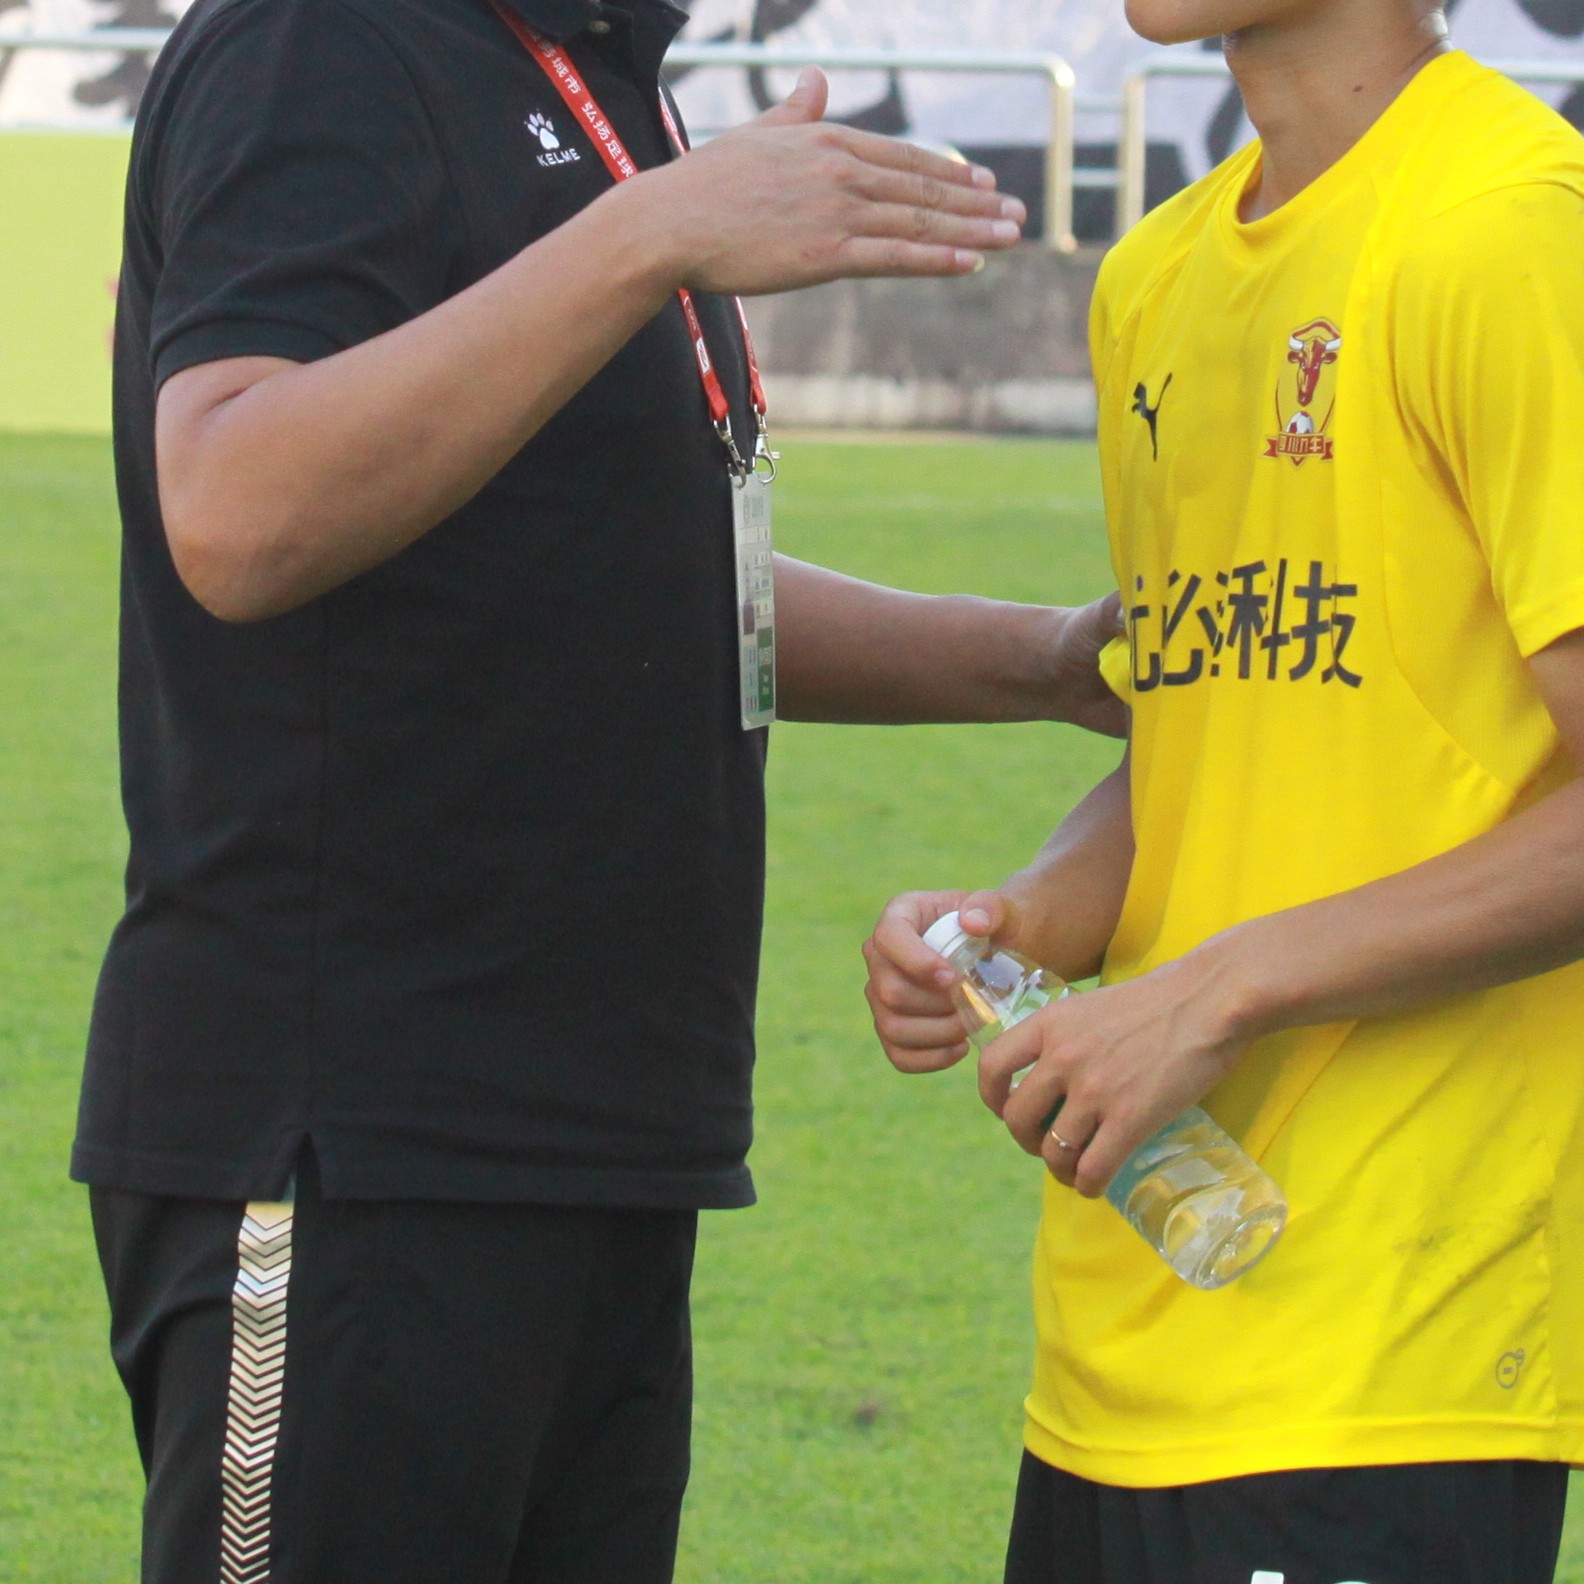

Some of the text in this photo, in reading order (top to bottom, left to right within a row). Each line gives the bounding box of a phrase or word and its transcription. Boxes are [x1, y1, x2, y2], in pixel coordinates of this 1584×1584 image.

[535, 148, 582, 168] KELME
[581, 102, 635, 178] 弘扬足球
